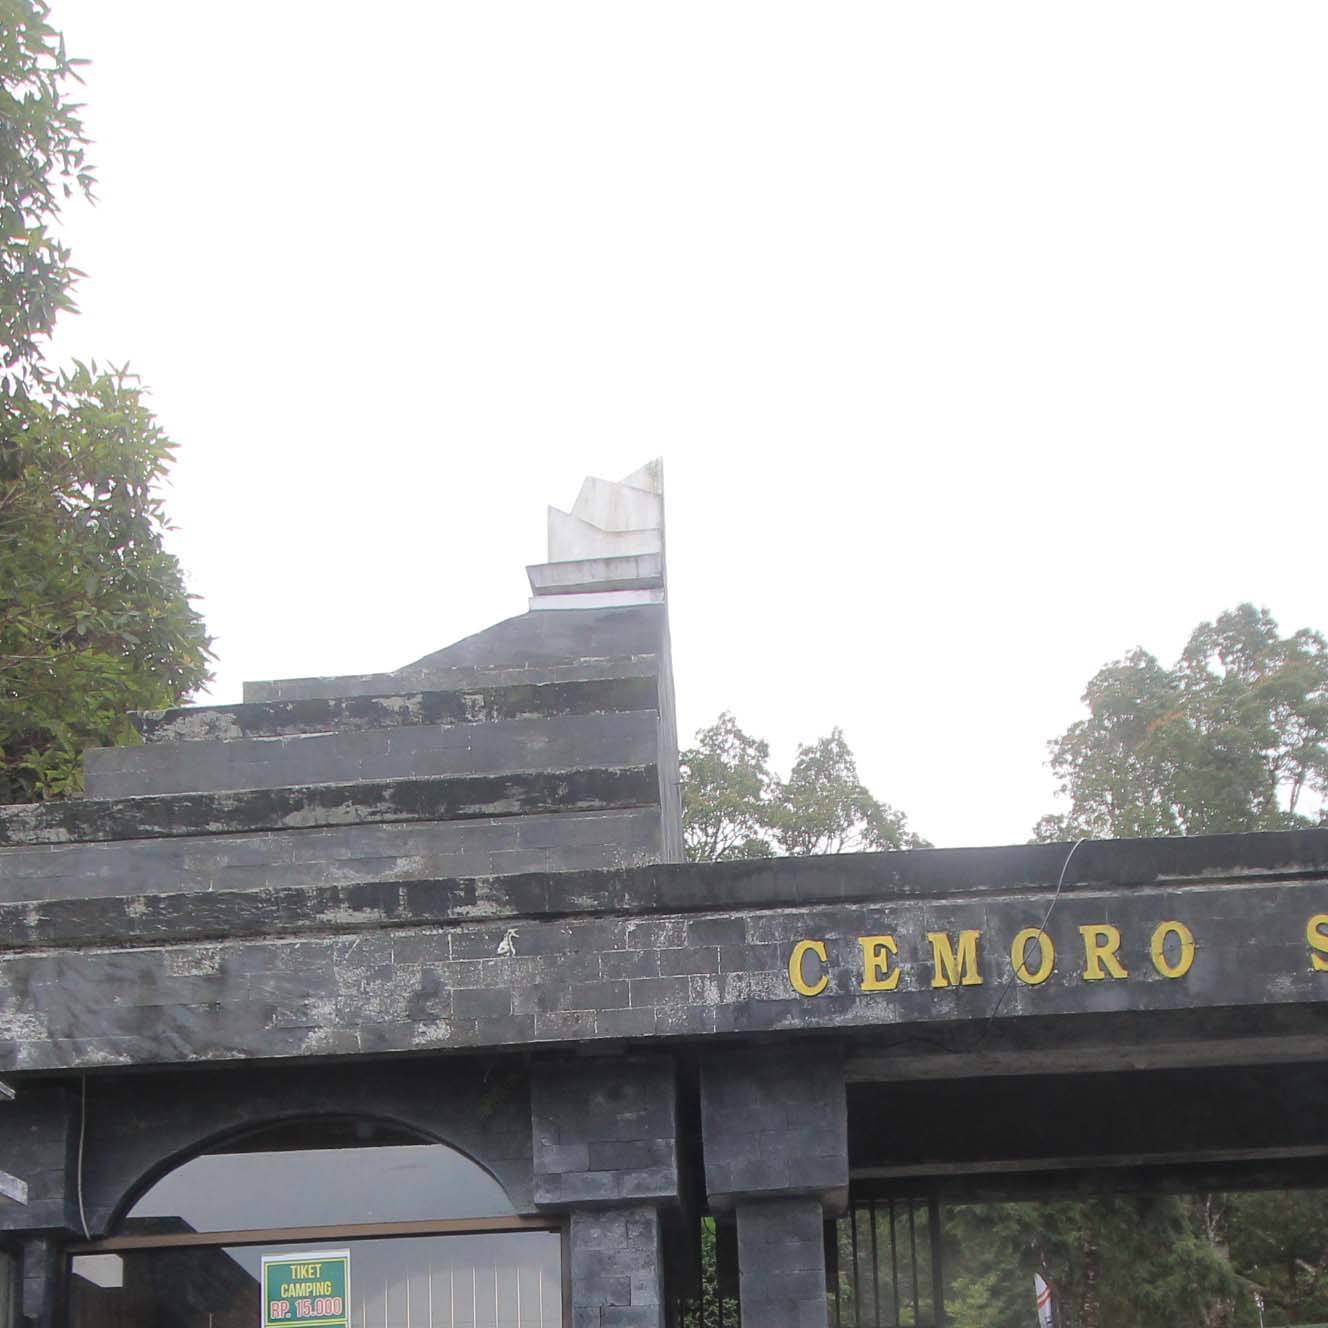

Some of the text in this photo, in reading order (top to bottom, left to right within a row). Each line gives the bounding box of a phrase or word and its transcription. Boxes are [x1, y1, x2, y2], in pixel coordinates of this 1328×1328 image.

[787, 920, 1196, 997] CEMORO
[290, 1263, 322, 1280] TIKET
[280, 1281, 333, 1298] CAMPING
[270, 1297, 343, 1319] RP. 15.000
